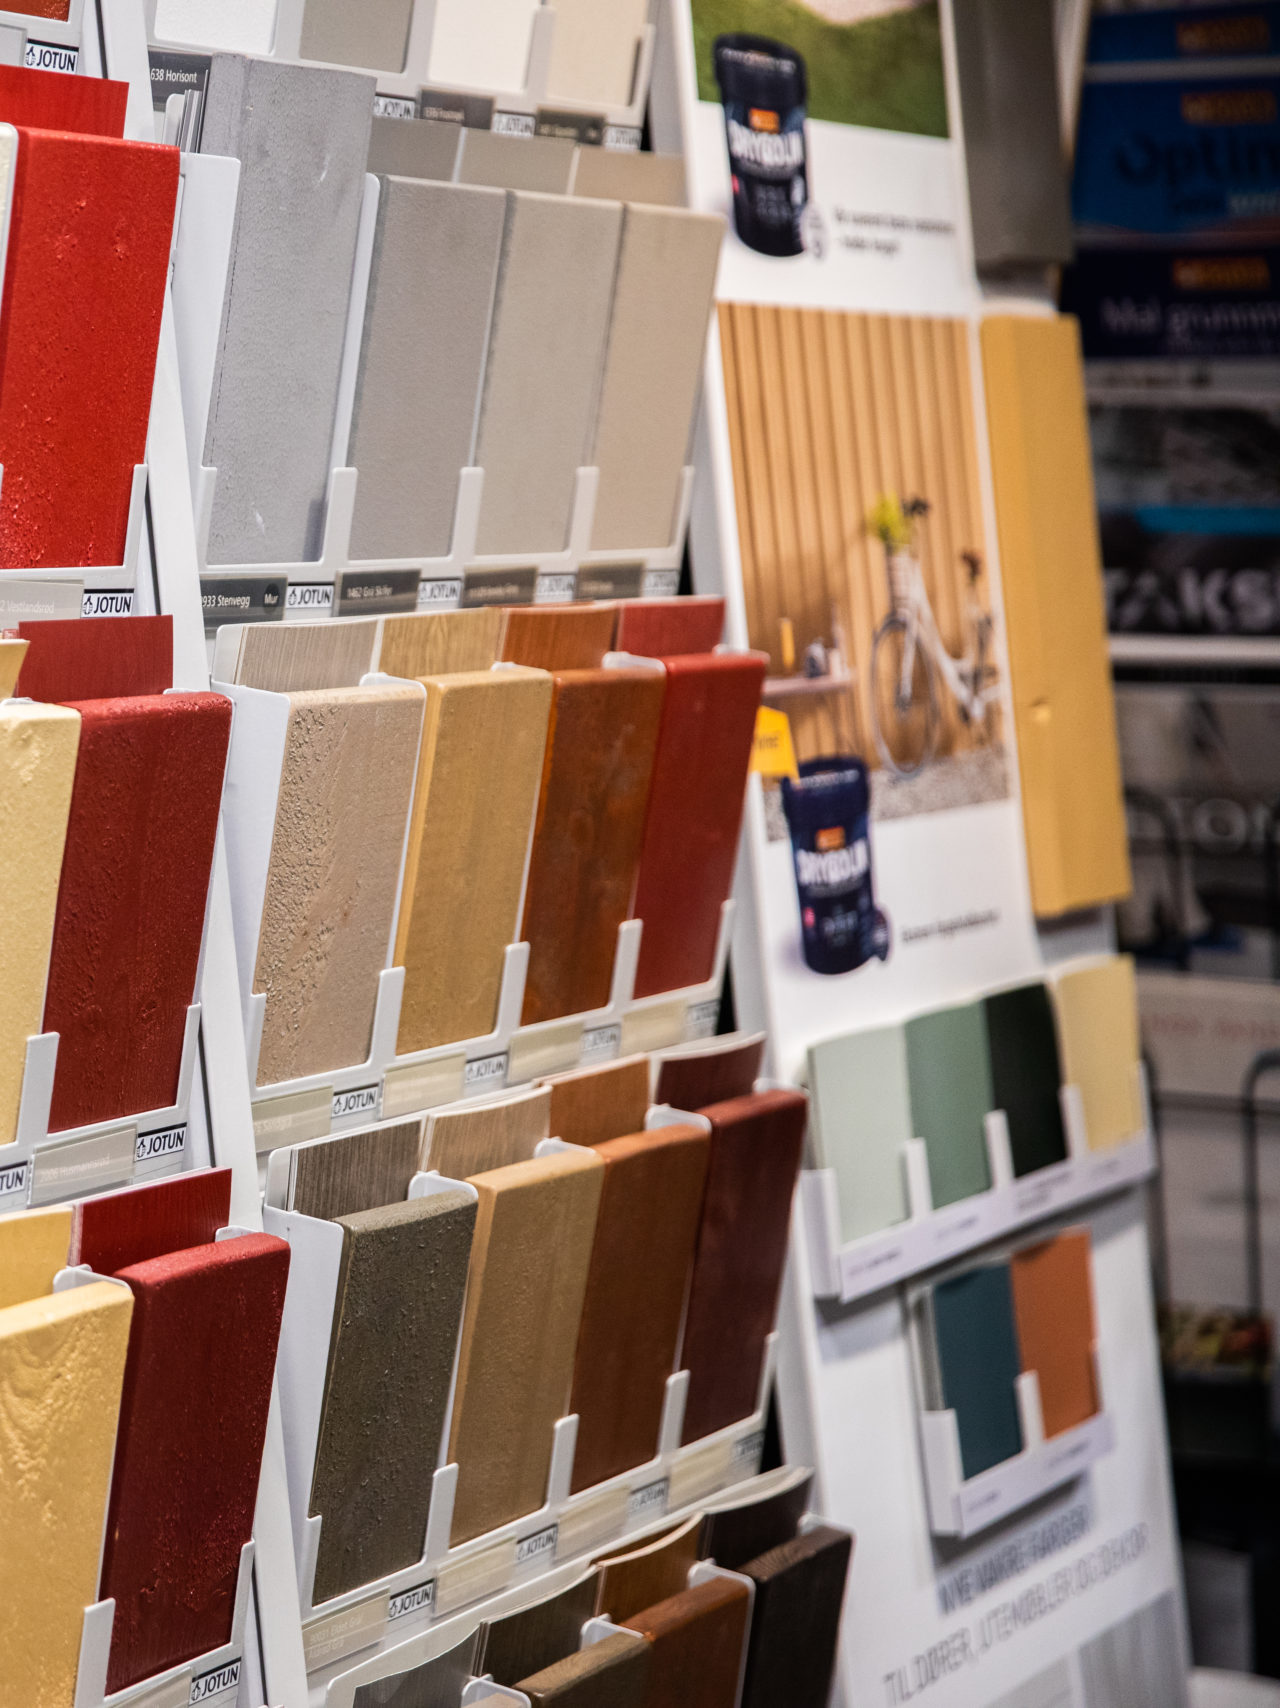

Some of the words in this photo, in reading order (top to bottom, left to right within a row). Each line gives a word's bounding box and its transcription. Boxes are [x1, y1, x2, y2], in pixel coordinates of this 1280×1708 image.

[37, 52, 76, 72] JOTUN
[166, 69, 198, 83] Horisont
[94, 592, 132, 613] JOTUN
[201, 595, 217, 607] 933
[218, 594, 250, 608] Stenvegg
[264, 593, 279, 604] Mur
[298, 589, 332, 605] JOTUN
[343, 1089, 376, 1112] JOTUN
[147, 1130, 185, 1155] JOTUN
[398, 1585, 432, 1614] JOTUN
[202, 1665, 239, 1697] JOTUN
